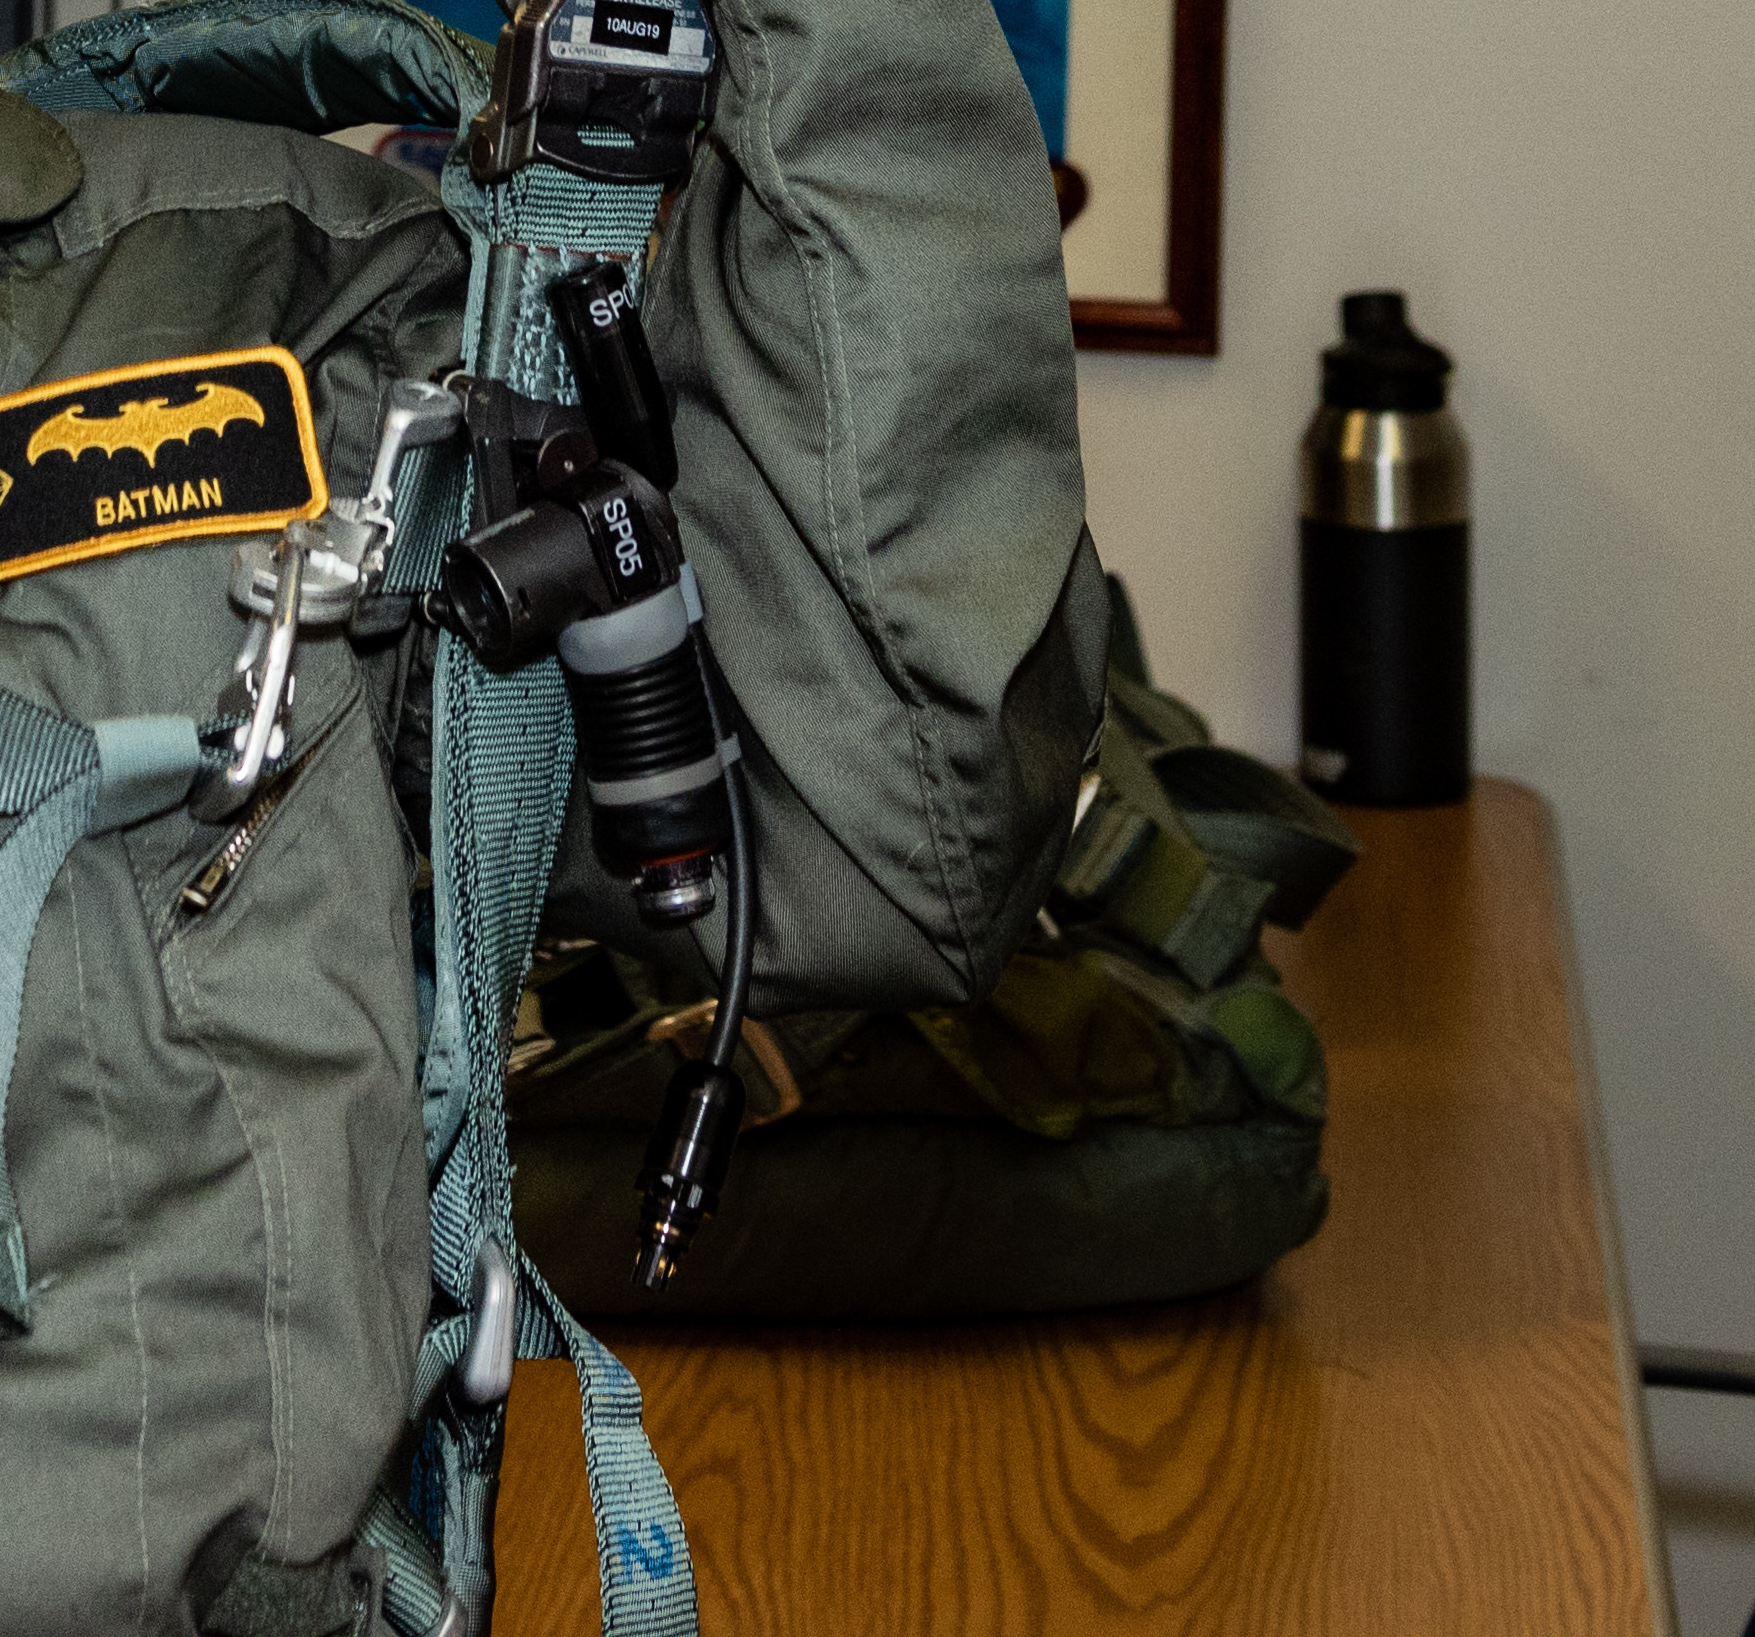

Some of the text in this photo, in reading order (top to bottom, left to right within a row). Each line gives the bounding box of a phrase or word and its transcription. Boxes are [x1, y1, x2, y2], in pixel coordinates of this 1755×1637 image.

[607, 16, 660, 39] 10AUG19
[95, 478, 223, 527] BATMAN
[602, 495, 644, 577] SP05
